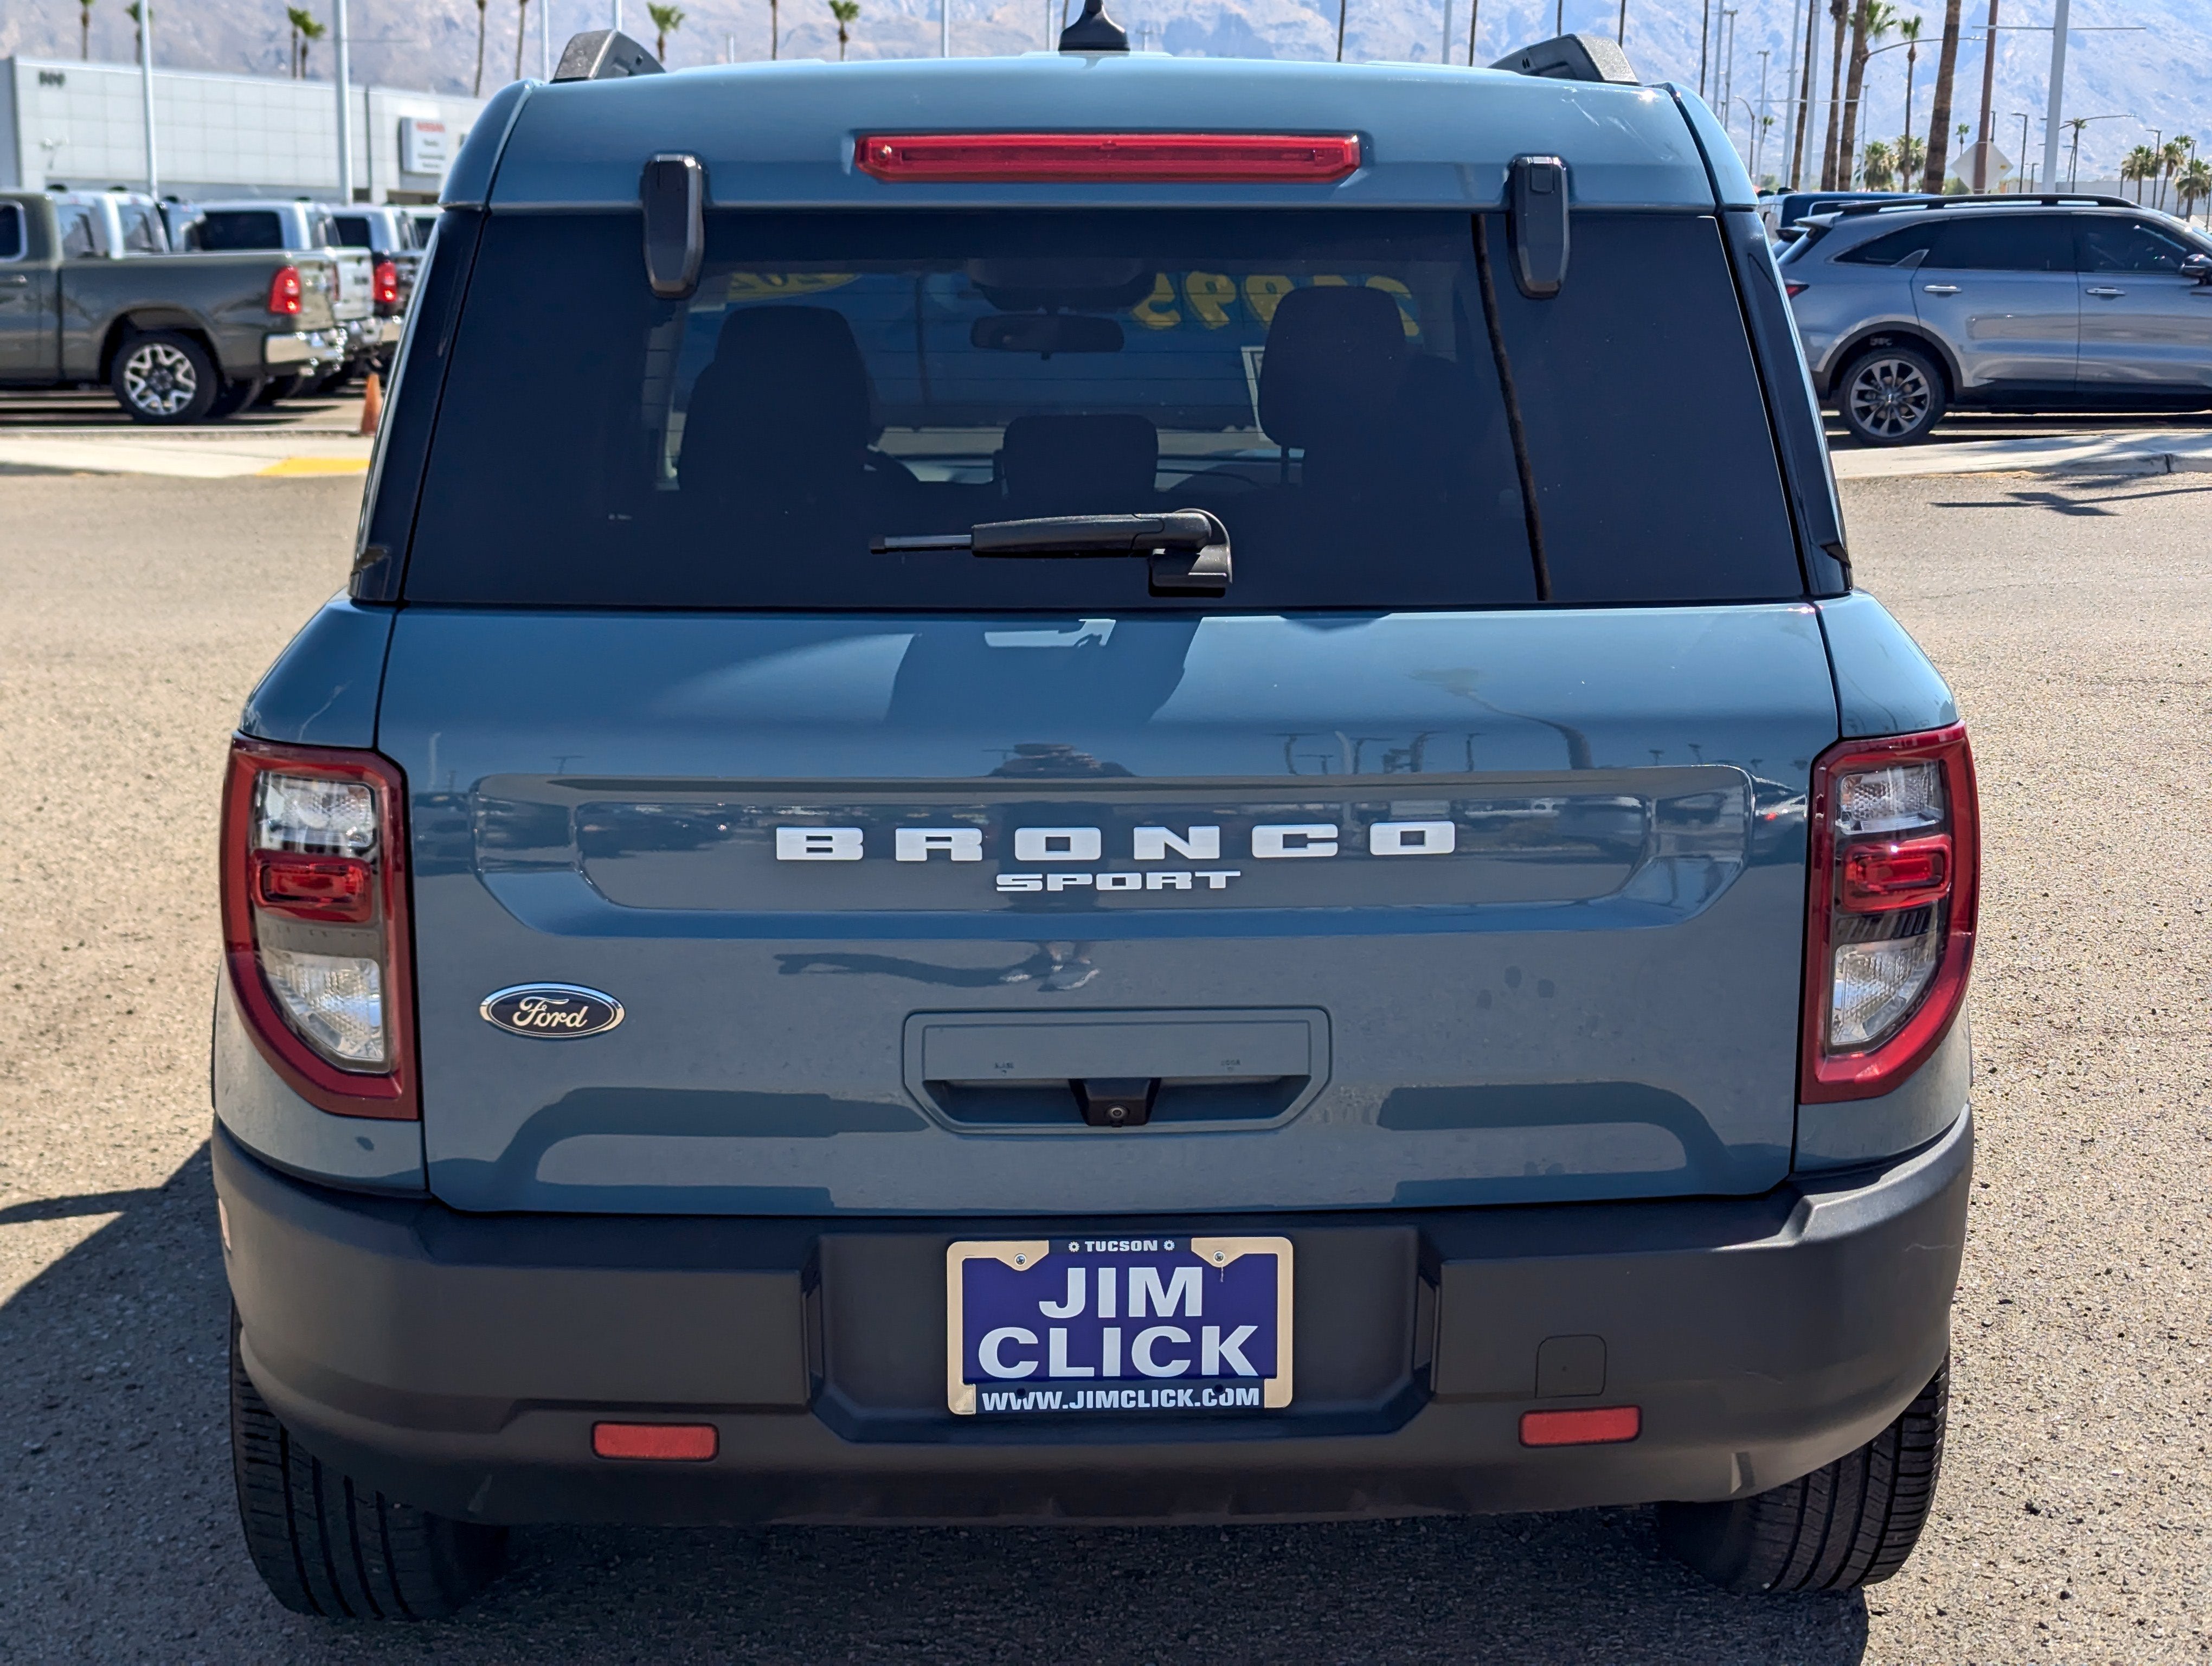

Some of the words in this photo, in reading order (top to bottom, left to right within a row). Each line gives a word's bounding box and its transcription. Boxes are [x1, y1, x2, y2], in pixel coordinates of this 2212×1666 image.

[776, 821, 1455, 861] BRONCO
[996, 870, 1241, 892] SPORT
[512, 996, 589, 1028] Ford
[1085, 1240, 1158, 1252] TUCSON
[1039, 1266, 1203, 1318] JIM
[978, 1325, 1258, 1378] CLICK
[982, 1388, 1259, 1411] WWW.JIMCLICK.COM
